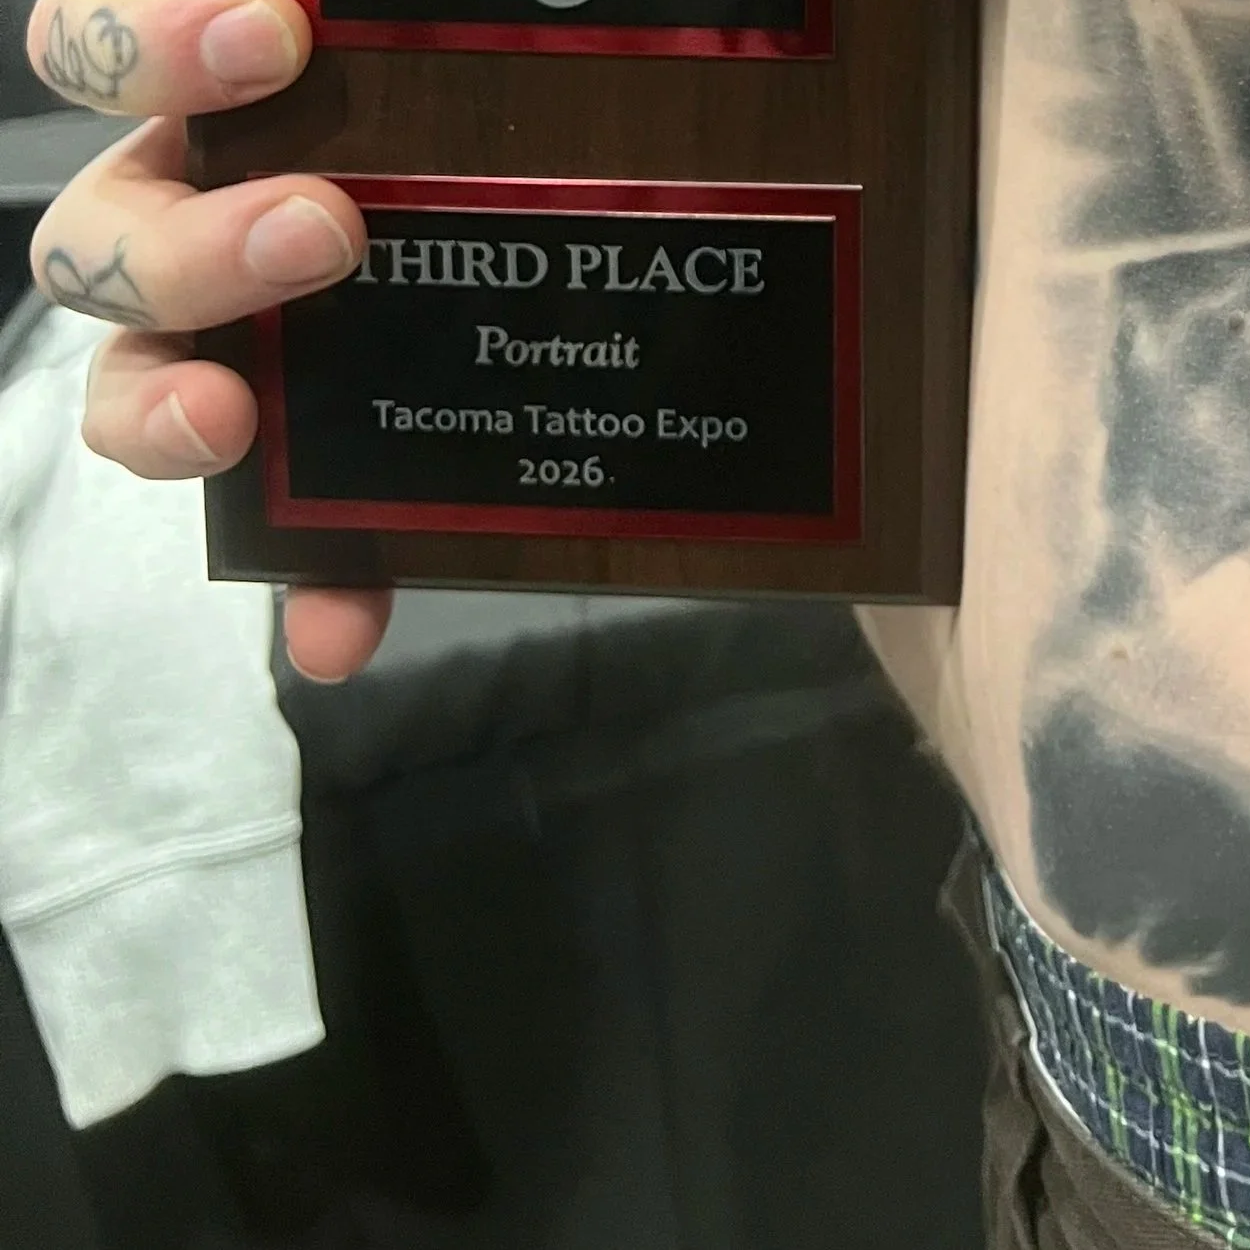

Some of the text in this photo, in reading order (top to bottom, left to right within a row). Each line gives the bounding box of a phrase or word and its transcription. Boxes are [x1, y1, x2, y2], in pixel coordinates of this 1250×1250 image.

[354, 238, 766, 295] THIRD PLACE
[475, 325, 640, 369] Portrait
[372, 399, 749, 449] Tacoma Tattoo Expo
